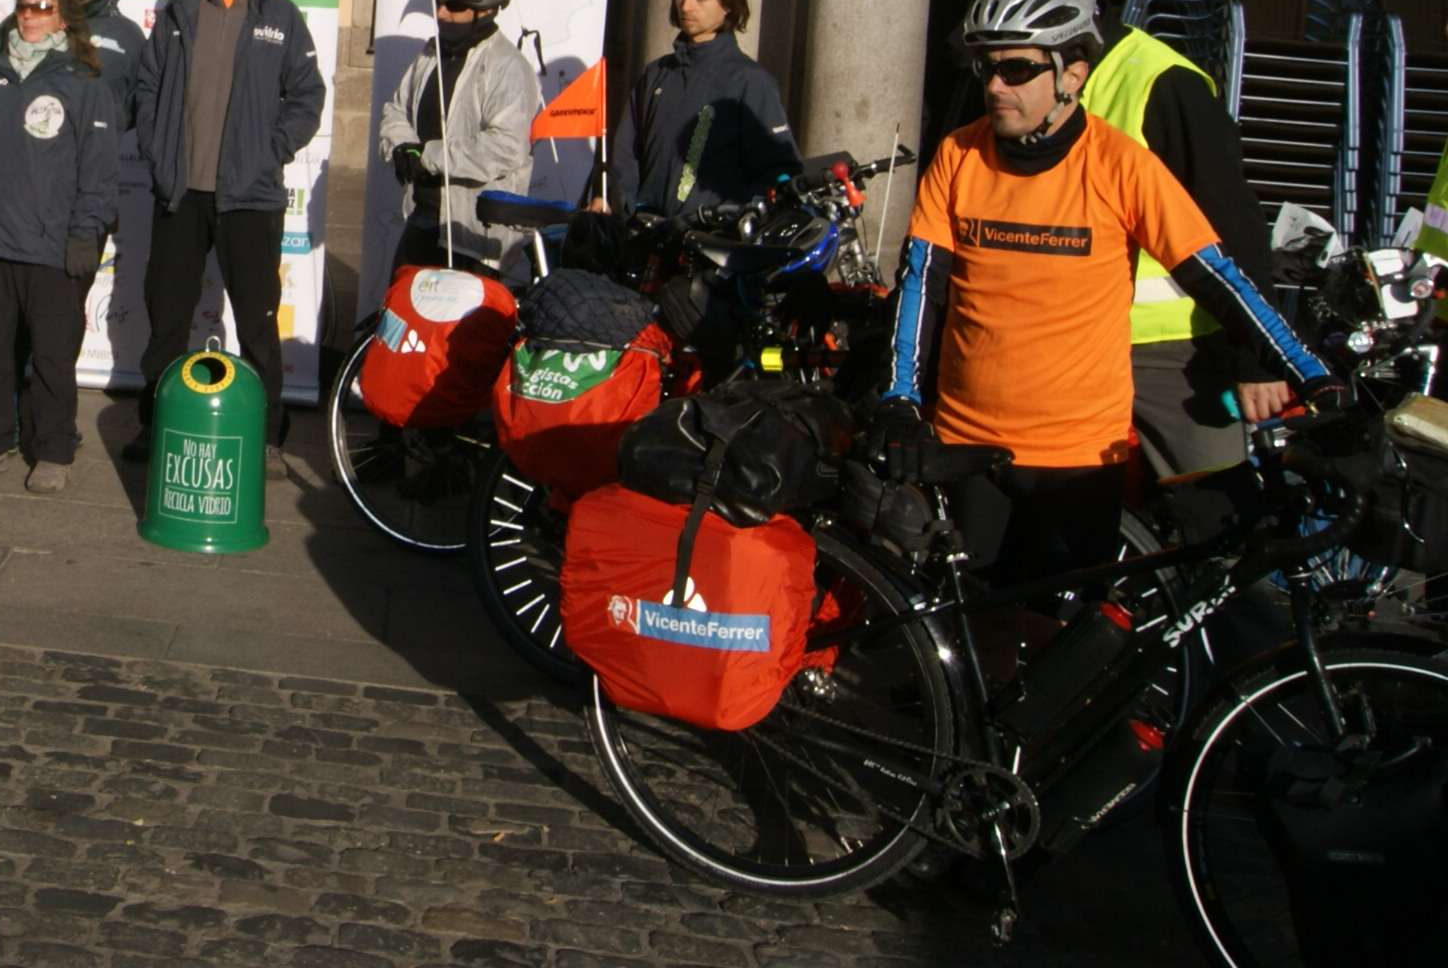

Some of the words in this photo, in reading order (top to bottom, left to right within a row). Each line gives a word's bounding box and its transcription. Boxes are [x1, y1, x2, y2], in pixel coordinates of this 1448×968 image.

[984, 226, 1089, 249] VicenteFerrer
[199, 442, 217, 459] HAY
[165, 452, 234, 491] EXCUSAS
[163, 487, 195, 514] RECICLA
[198, 496, 232, 517] VIDRIO
[644, 609, 764, 640] VicenteFerrer
